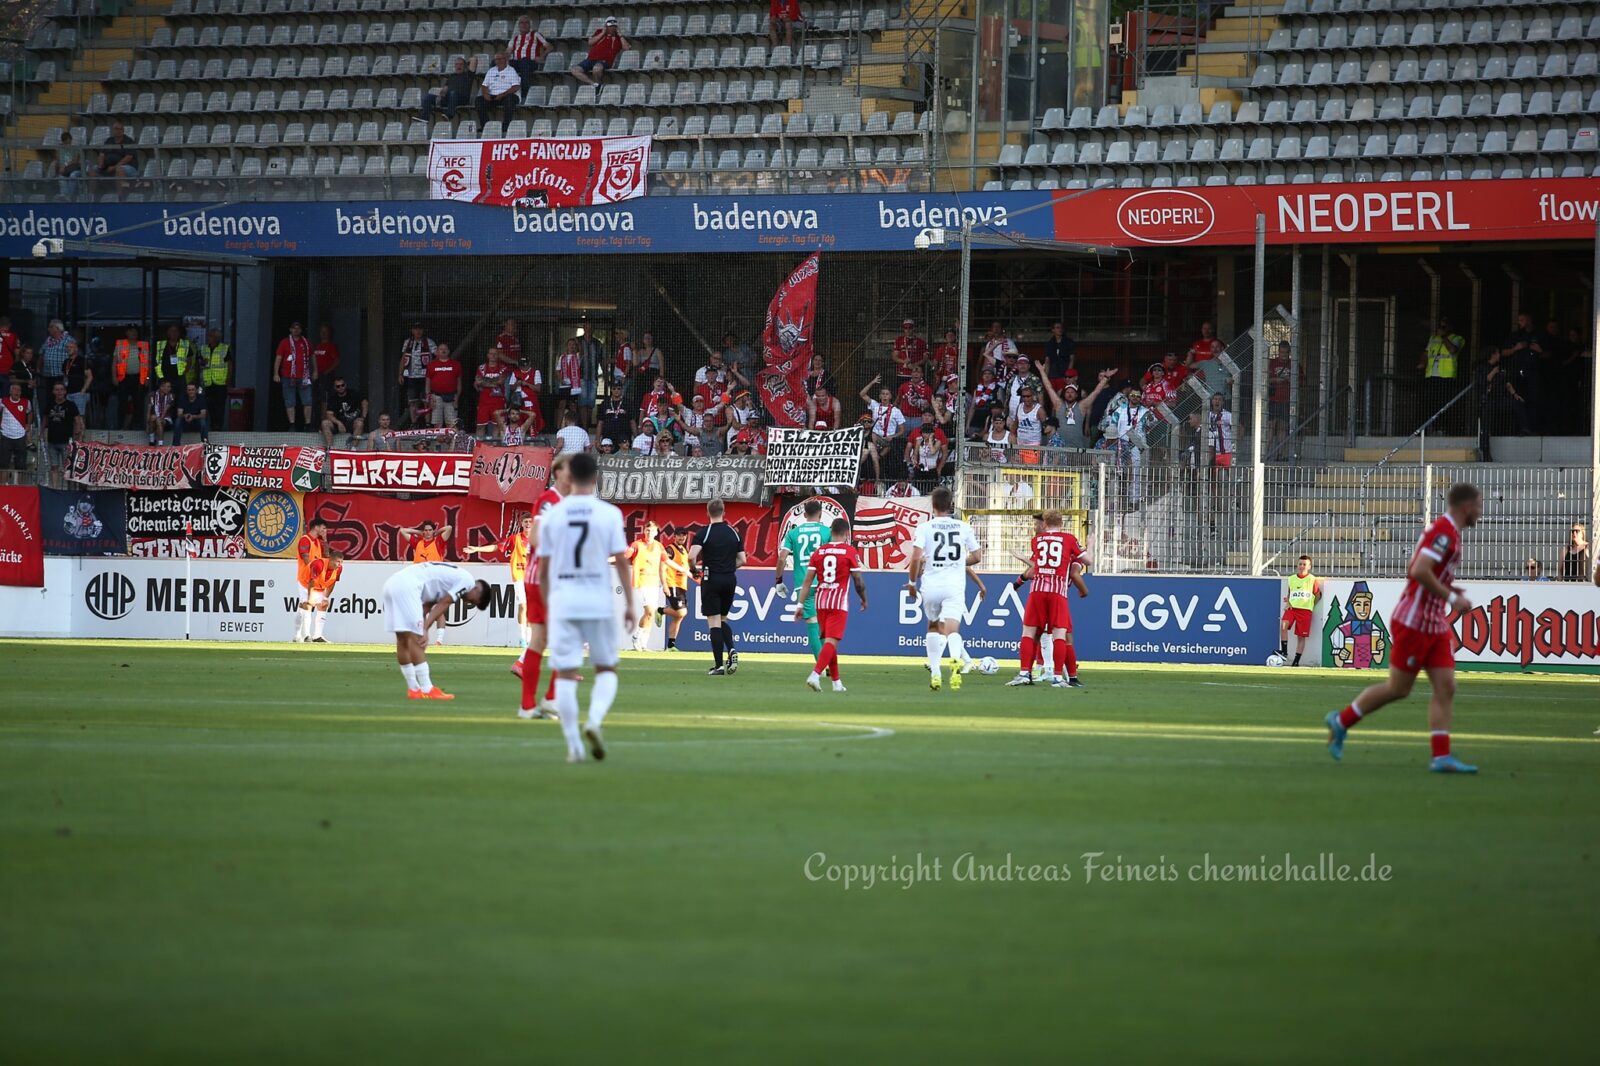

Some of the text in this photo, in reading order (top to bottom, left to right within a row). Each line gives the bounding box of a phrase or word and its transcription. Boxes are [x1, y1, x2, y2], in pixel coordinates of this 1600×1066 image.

[443, 157, 466, 167] HFC
[491, 143, 520, 161] HFC
[529, 142, 592, 160] FANCLUB
[608, 150, 641, 167] HFC
[500, 166, 576, 198] Edelfans
[513, 206, 635, 233] badenova
[692, 203, 819, 231] badenova
[879, 200, 1009, 229] badenova
[1127, 207, 1203, 226] NEOPERL
[1277, 191, 1470, 232] NEOPERL
[1538, 193, 1599, 221] flow
[0, 210, 108, 236] adenova
[163, 209, 281, 236] badenova
[336, 208, 456, 235] badenova
[768, 427, 861, 444] TELEKOM
[243, 446, 284, 457] SEKTION
[767, 442, 860, 457] BOYKOTTIEREN
[230, 456, 292, 470] MANSFELD
[333, 459, 472, 486] SURREALE
[766, 457, 857, 471] MONTAGSSPIELE
[231, 472, 284, 489] SÜDHARZ
[595, 470, 764, 500] DIONVERBO
[764, 470, 855, 484] NICHT AKZEPTIEREN
[130, 494, 182, 513] Libertà
[227, 487, 248, 503] HFC
[2, 503, 33, 541] ANHALT
[128, 514, 218, 533] Chemie Halle
[890, 505, 921, 525] HFC
[568, 521, 590, 569] 7
[797, 533, 822, 562] 23
[933, 531, 961, 562] 25
[1036, 541, 1063, 568] 39
[822, 555, 837, 583] 8
[85, 572, 136, 619] AHP
[146, 578, 265, 614] MERKLE
[284, 593, 384, 619] w.ahp.
[899, 590, 982, 625] BV
[1111, 594, 1199, 631] BGV
[220, 621, 265, 633] BEWEGT
[742, 631, 809, 647] Versicherung
[1446, 593, 1600, 668] othau
[898, 635, 1021, 652] Badis rsicherung
[1110, 641, 1247, 656] Badische Versicherungen
